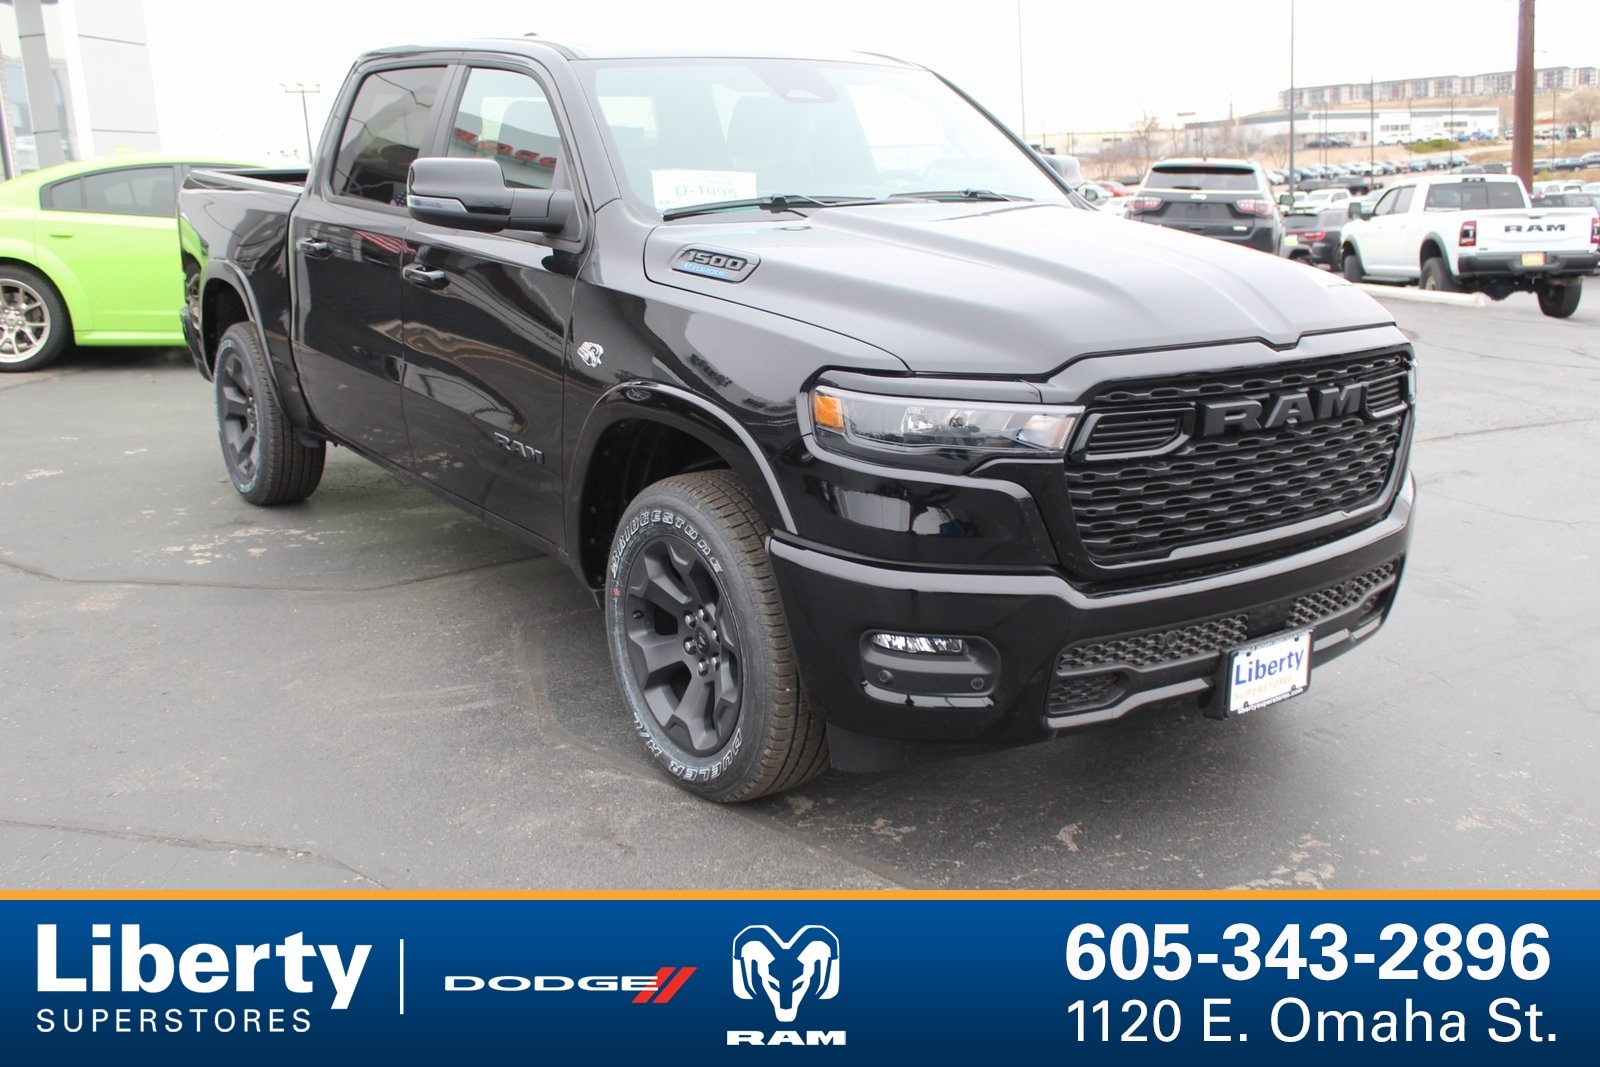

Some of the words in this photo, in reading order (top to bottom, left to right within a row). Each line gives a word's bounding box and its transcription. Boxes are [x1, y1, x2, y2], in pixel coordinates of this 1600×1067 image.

[1504, 224, 1566, 233] RAM
[687, 251, 746, 271] 1500
[1202, 382, 1364, 437] RAM
[494, 431, 545, 465] RAM
[609, 509, 723, 580] BRIDGESTONE
[1235, 649, 1304, 686] Liberty
[668, 727, 743, 782] DUELER
